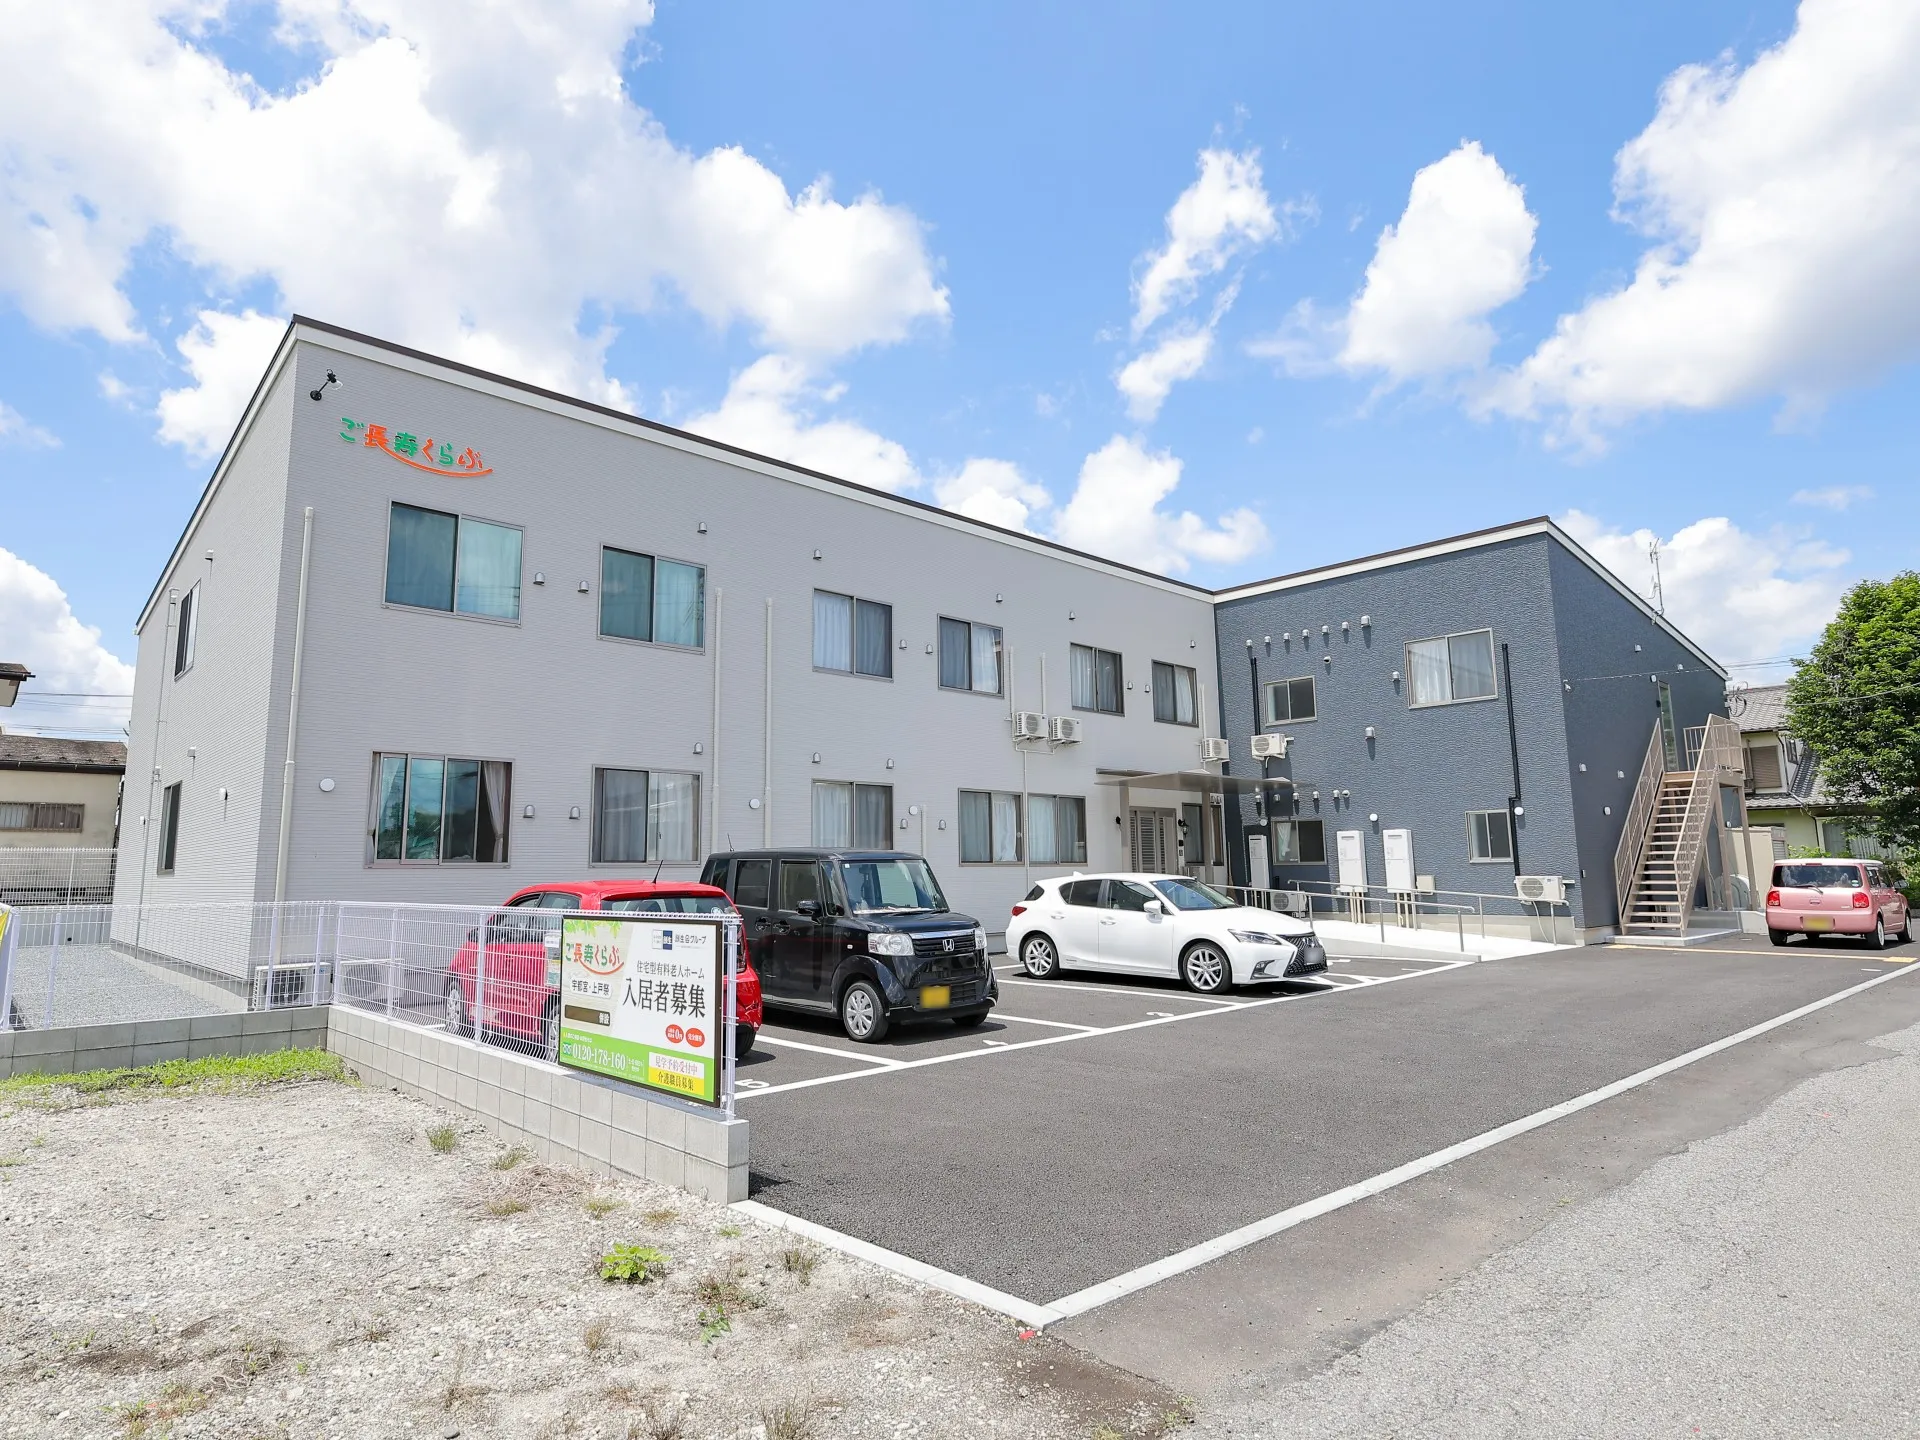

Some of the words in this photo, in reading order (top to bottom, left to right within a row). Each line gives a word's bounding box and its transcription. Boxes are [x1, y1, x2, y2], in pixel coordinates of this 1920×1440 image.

[339, 416, 483, 469] ご長寿くらぶ
[565, 943, 621, 967] ご長寿くらぶ
[637, 961, 705, 979] 住宅型有料老人ホーム
[622, 978, 706, 1018] 入居者募集
[573, 1043, 625, 1071] 0120-178-160
[655, 1055, 698, 1076] 見学予約受付中
[657, 1071, 694, 1091] 介護職員募集
